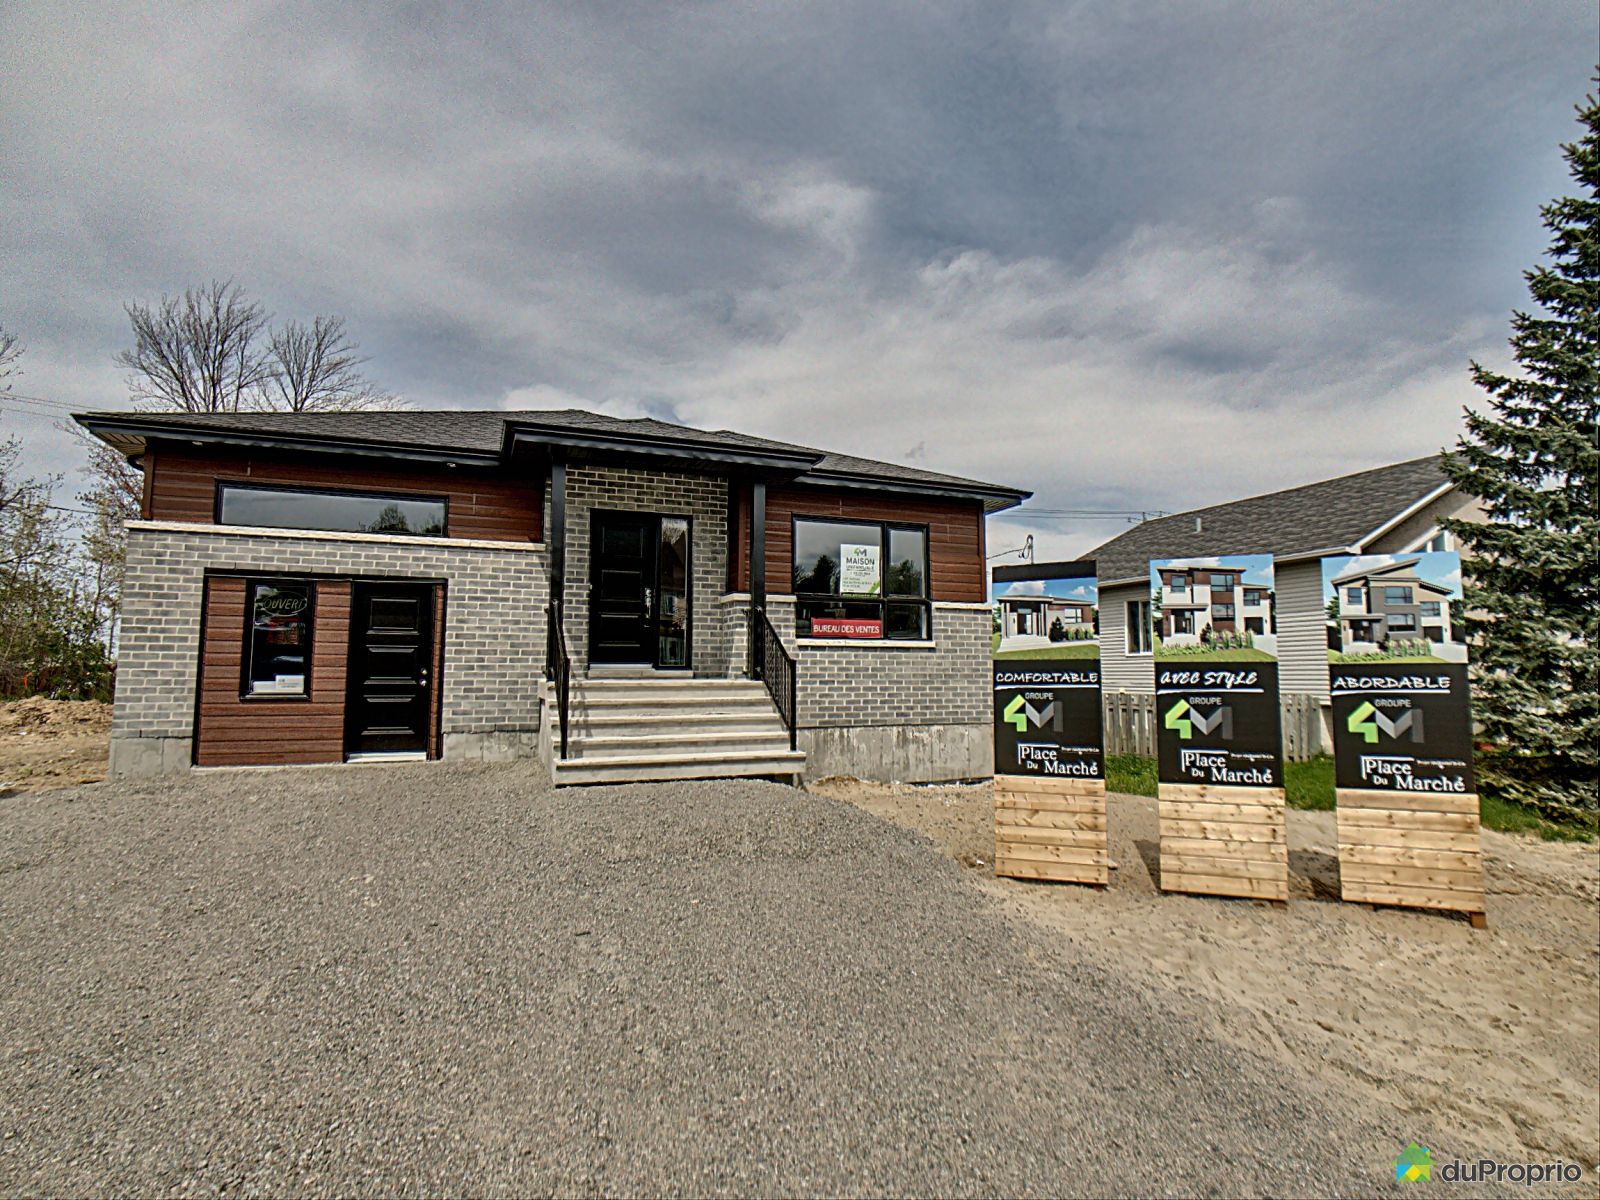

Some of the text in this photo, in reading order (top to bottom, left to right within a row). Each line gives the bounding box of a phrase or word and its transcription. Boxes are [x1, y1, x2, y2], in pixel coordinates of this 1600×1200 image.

[846, 557, 875, 565] MAISON
[814, 624, 880, 634] BUREAU DES VENTES
[996, 673, 1098, 682] COMFORTABLE
[1333, 676, 1451, 689] ABORDABLE
[1025, 692, 1054, 700] GROUPE
[1189, 697, 1222, 705] GROUPE
[1375, 699, 1411, 708] GROUPE
[1021, 746, 1057, 760] Place
[1185, 752, 1226, 768] Place
[1044, 761, 1098, 775] Marché
[1366, 760, 1412, 775] Place
[1211, 768, 1272, 784] Marché
[1395, 775, 1465, 792] Marché
